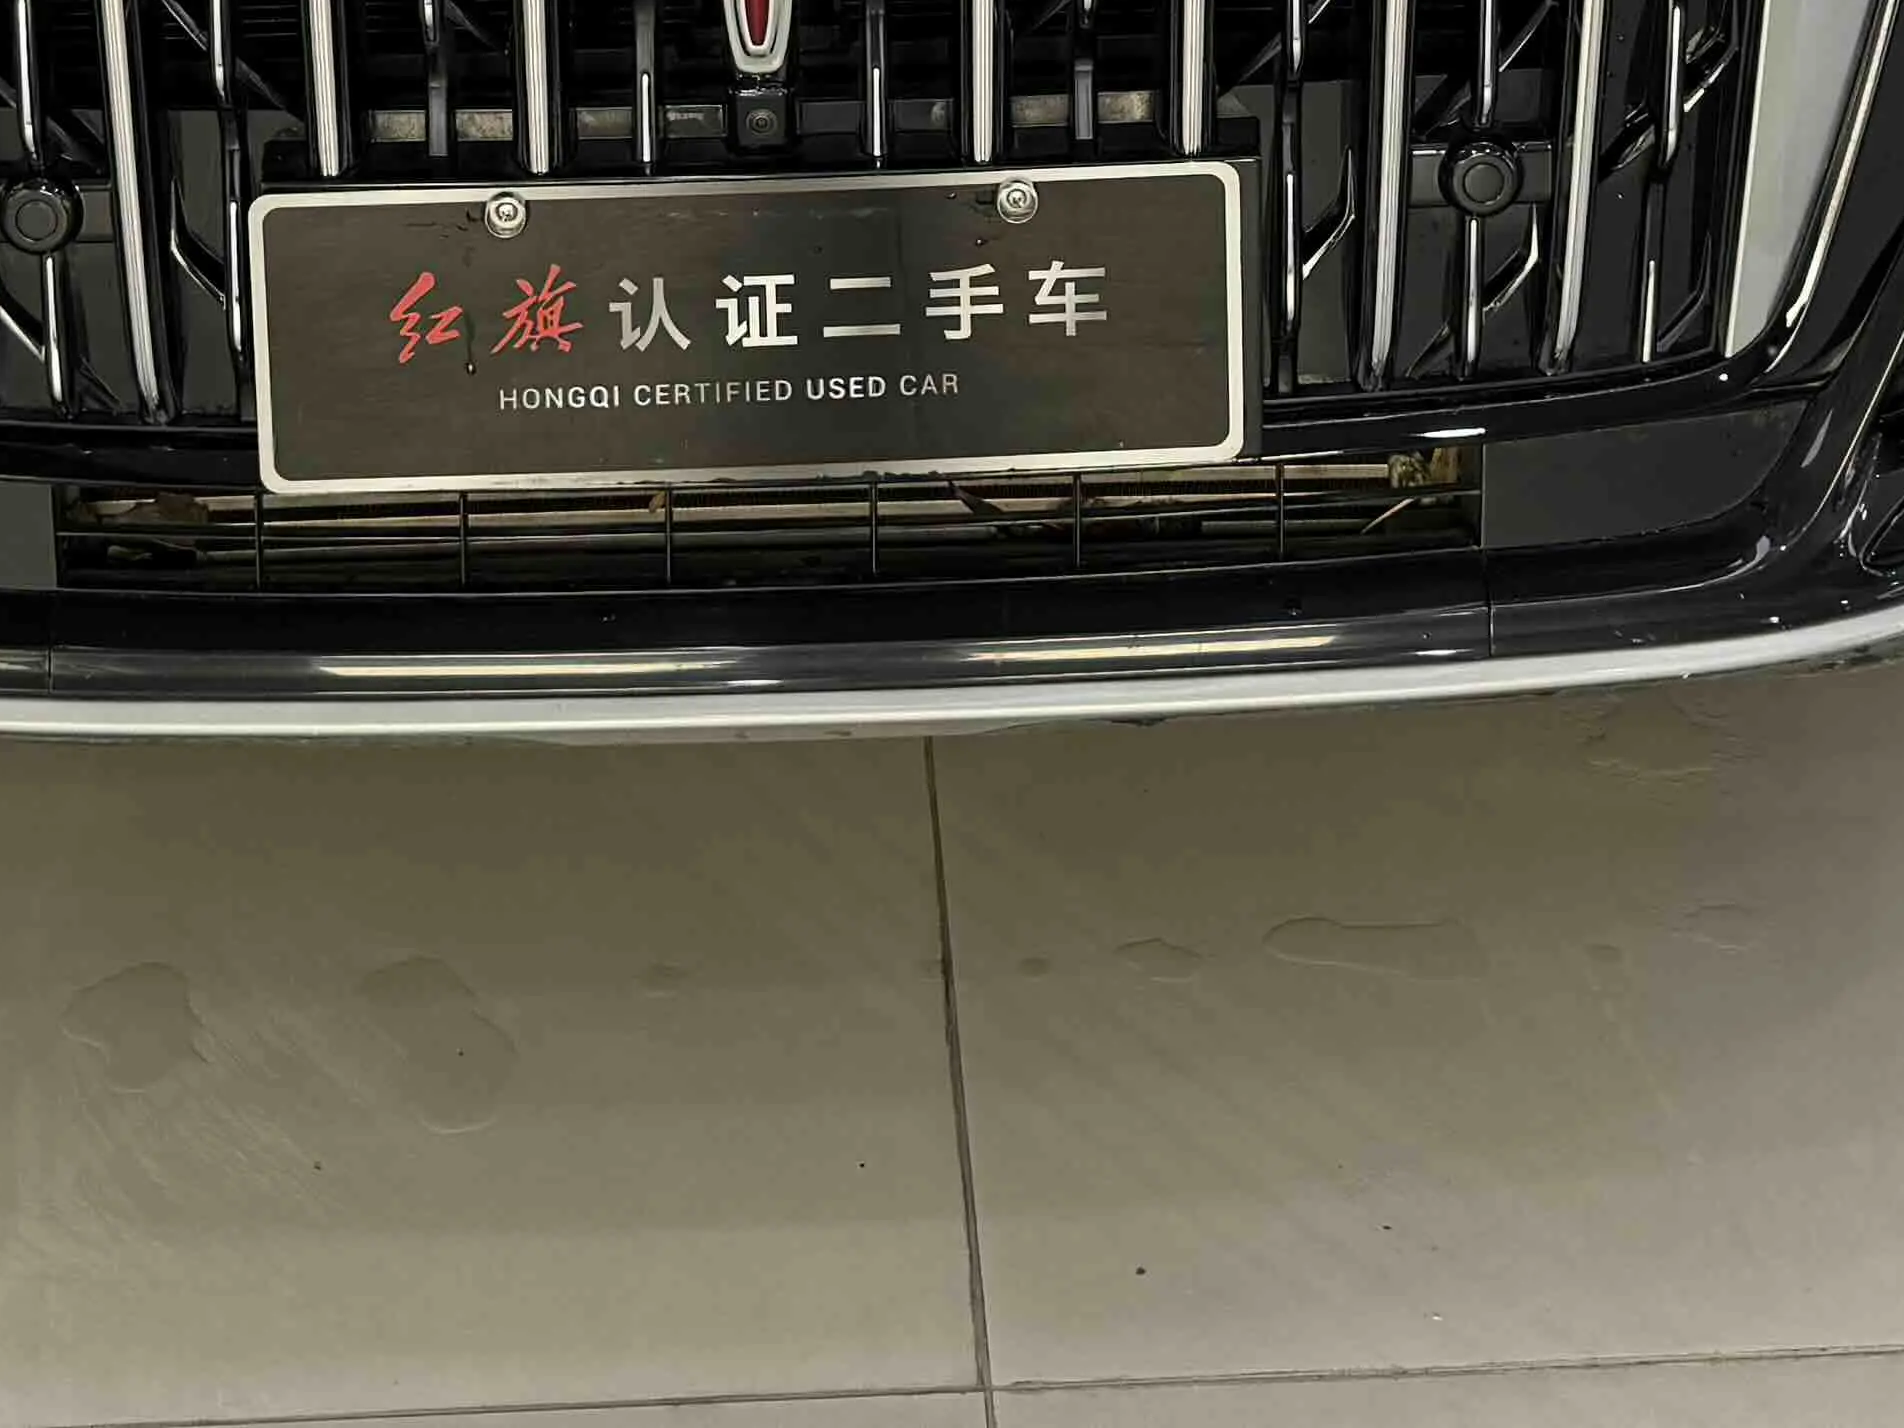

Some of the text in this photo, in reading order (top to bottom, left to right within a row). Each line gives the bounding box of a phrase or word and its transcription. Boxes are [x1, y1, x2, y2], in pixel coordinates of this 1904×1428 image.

[389, 259, 1109, 363] 红旗认证二手车
[498, 372, 960, 412] HONGQI CERTIFIED USED CAR
